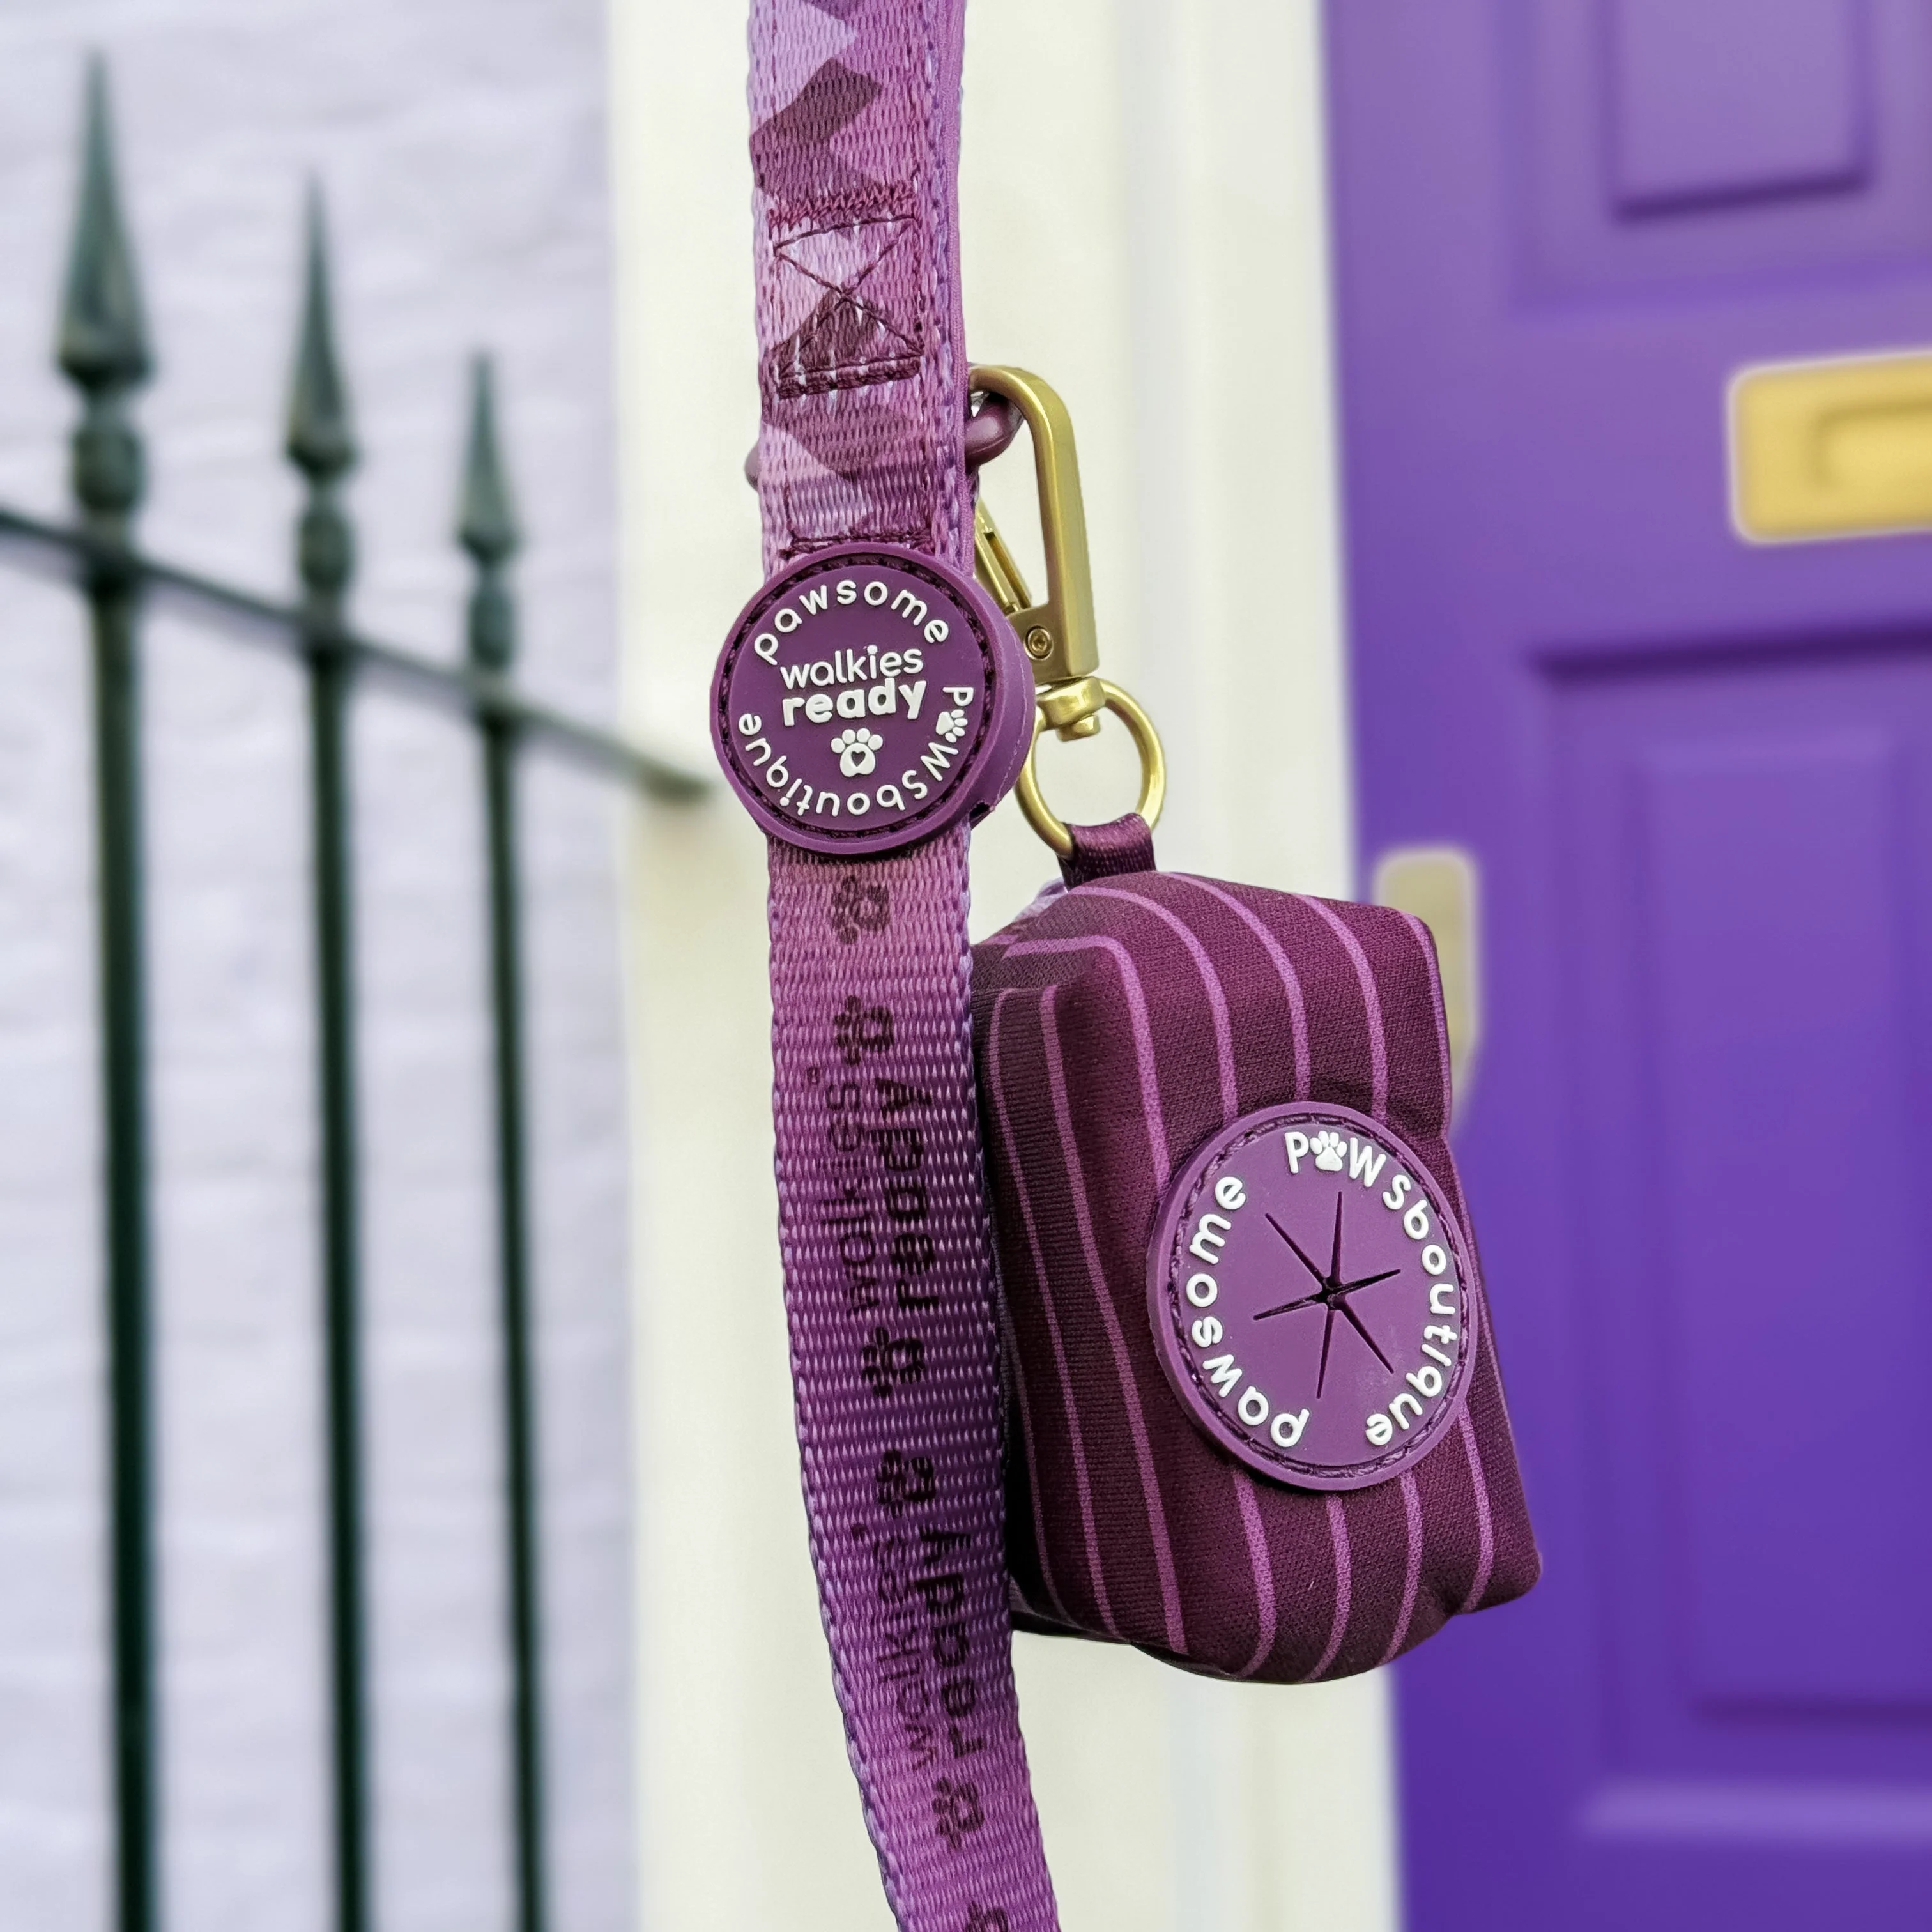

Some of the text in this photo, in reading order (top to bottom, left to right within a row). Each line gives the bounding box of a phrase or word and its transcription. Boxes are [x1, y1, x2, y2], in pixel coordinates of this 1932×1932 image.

[754, 579, 949, 666] pawsome
[781, 645, 924, 690] walkies
[782, 678, 926, 726] ready
[818, 1081, 880, 1315] walkies
[868, 1078, 939, 1311] ready
[1186, 1176, 1310, 1448] pawsome
[914, 1527, 985, 1758] ready
